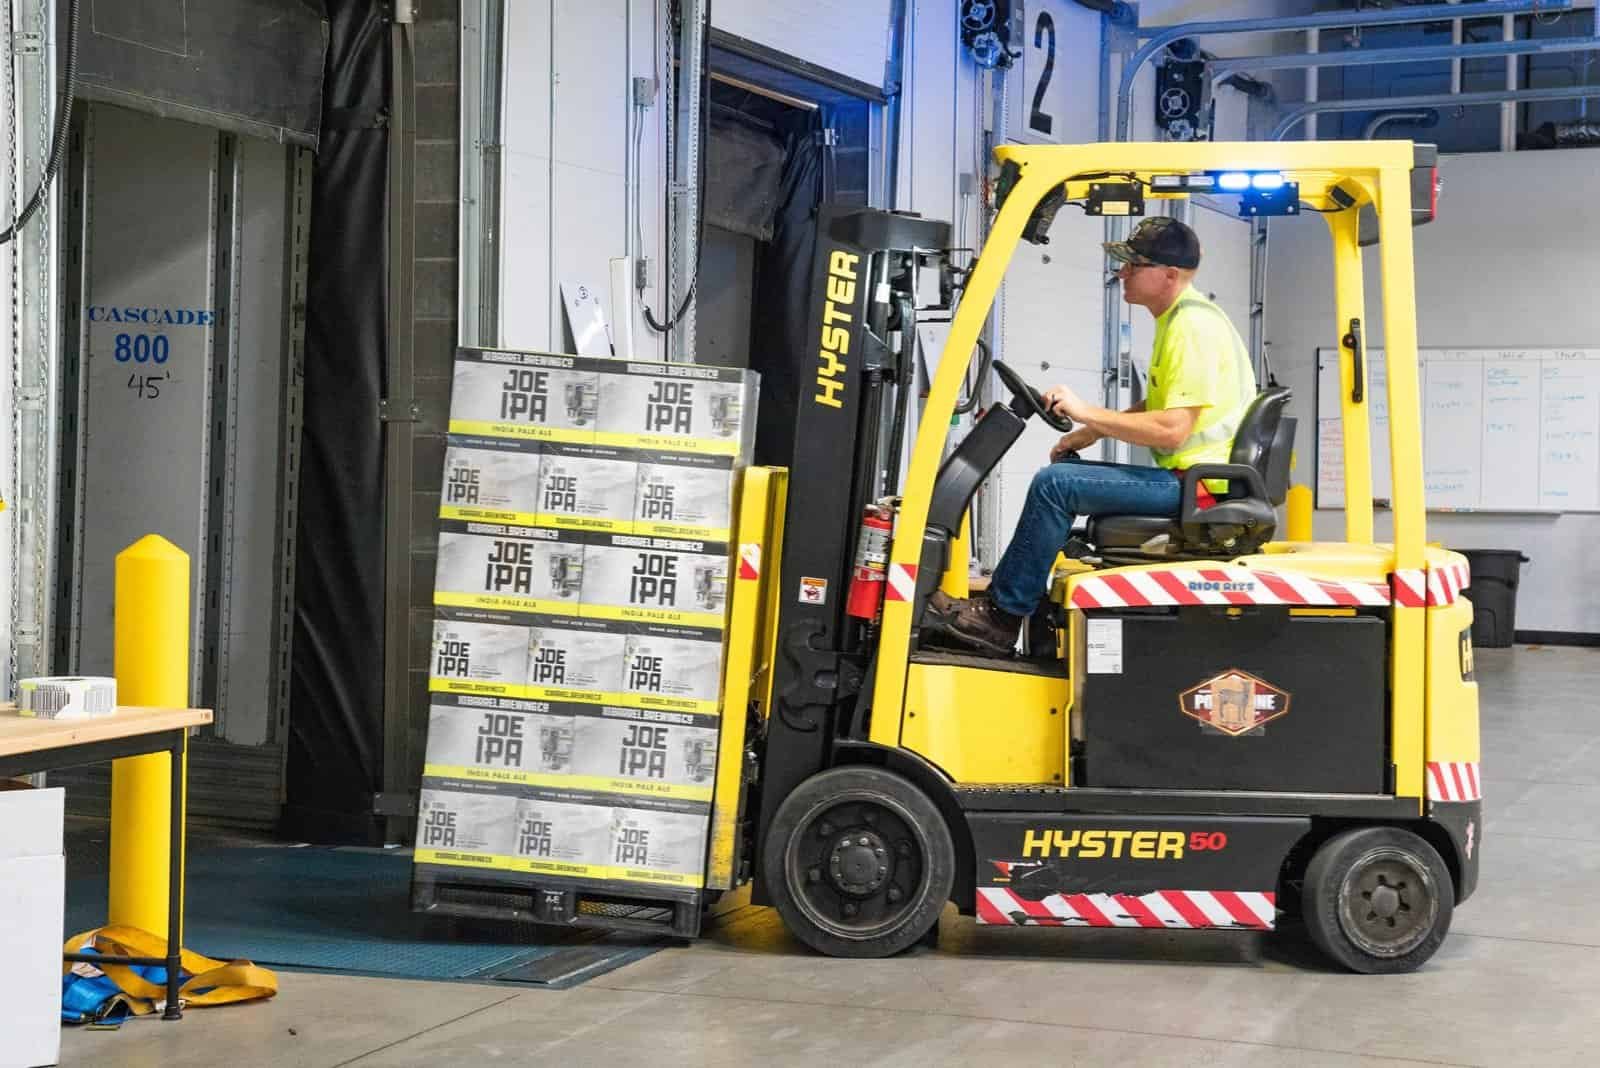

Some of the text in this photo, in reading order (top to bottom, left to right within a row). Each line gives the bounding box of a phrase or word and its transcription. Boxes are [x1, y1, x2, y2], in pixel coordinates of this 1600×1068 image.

[1030, 10, 1055, 134] 2
[89, 306, 216, 326] CASCADE
[815, 250, 859, 408] HYSTER
[114, 334, 169, 364] 800
[503, 369, 549, 393] JOE
[648, 381, 694, 405] JOE
[500, 392, 548, 422] IPA
[646, 404, 692, 433] IPA
[449, 468, 480, 484] JOE
[546, 476, 577, 492] JOE
[447, 483, 479, 504] IPA
[544, 491, 576, 512] IPA
[644, 484, 675, 500] JOE
[642, 499, 673, 520] IPA
[488, 541, 534, 565] JOE
[633, 553, 678, 577] JOE
[486, 563, 533, 593] IPA
[630, 576, 676, 606] IPA
[439, 641, 471, 658] JOE
[535, 648, 566, 664] JOE
[437, 657, 469, 677] IPA
[533, 663, 565, 684] IPA
[632, 656, 663, 671] JOE
[630, 671, 661, 692] IPA
[478, 713, 525, 738] JOE
[623, 725, 668, 749] JOE
[476, 736, 523, 767] IPA
[619, 748, 667, 778] IPA
[426, 811, 457, 827] JOE
[522, 820, 552, 837] JOE
[424, 826, 456, 847] IPA
[519, 835, 551, 857] IPA
[618, 829, 649, 845] JOE
[1022, 829, 1227, 859] HYSTER 50
[616, 844, 648, 865] IPA
